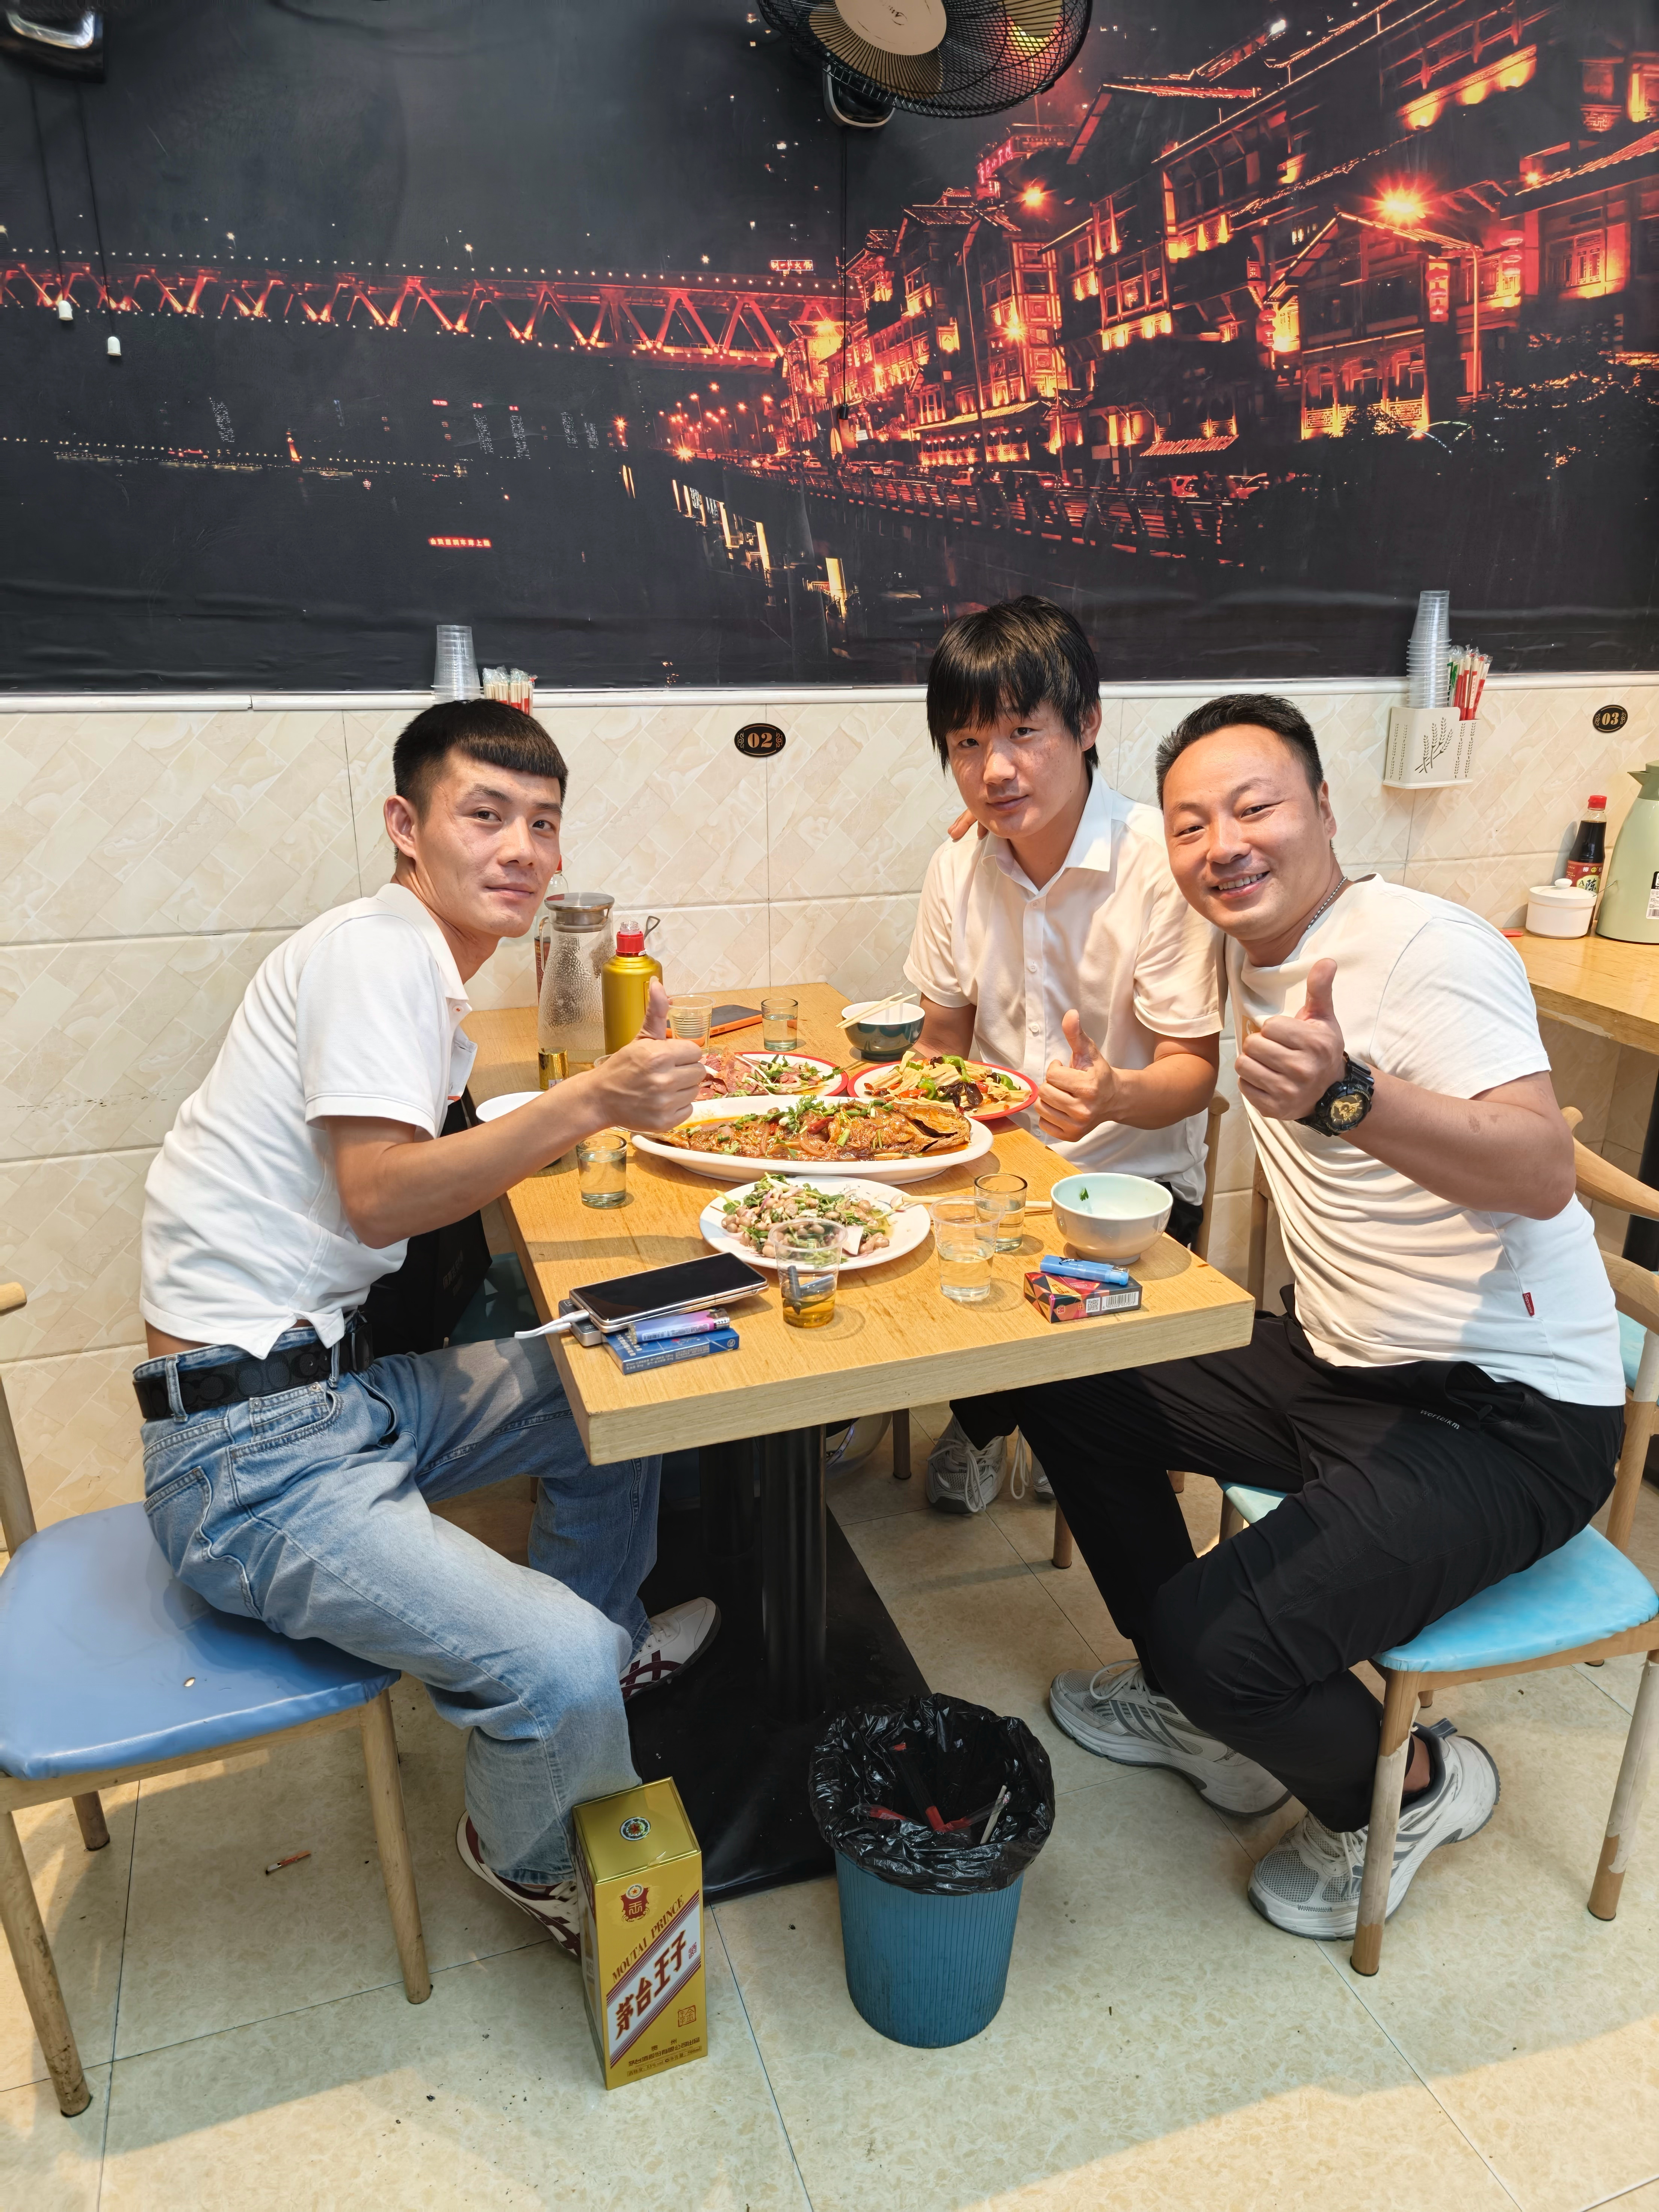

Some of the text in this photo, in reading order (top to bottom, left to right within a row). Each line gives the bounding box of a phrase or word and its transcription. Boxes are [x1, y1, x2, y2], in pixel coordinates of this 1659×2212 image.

[1602, 712, 1619, 725] 03
[748, 733, 772, 748] 02
[1524, 1294, 1532, 1313] Supreme
[612, 1894, 684, 1984] MOUTAI PRINCE
[615, 1929, 687, 2041] 茅台王子
